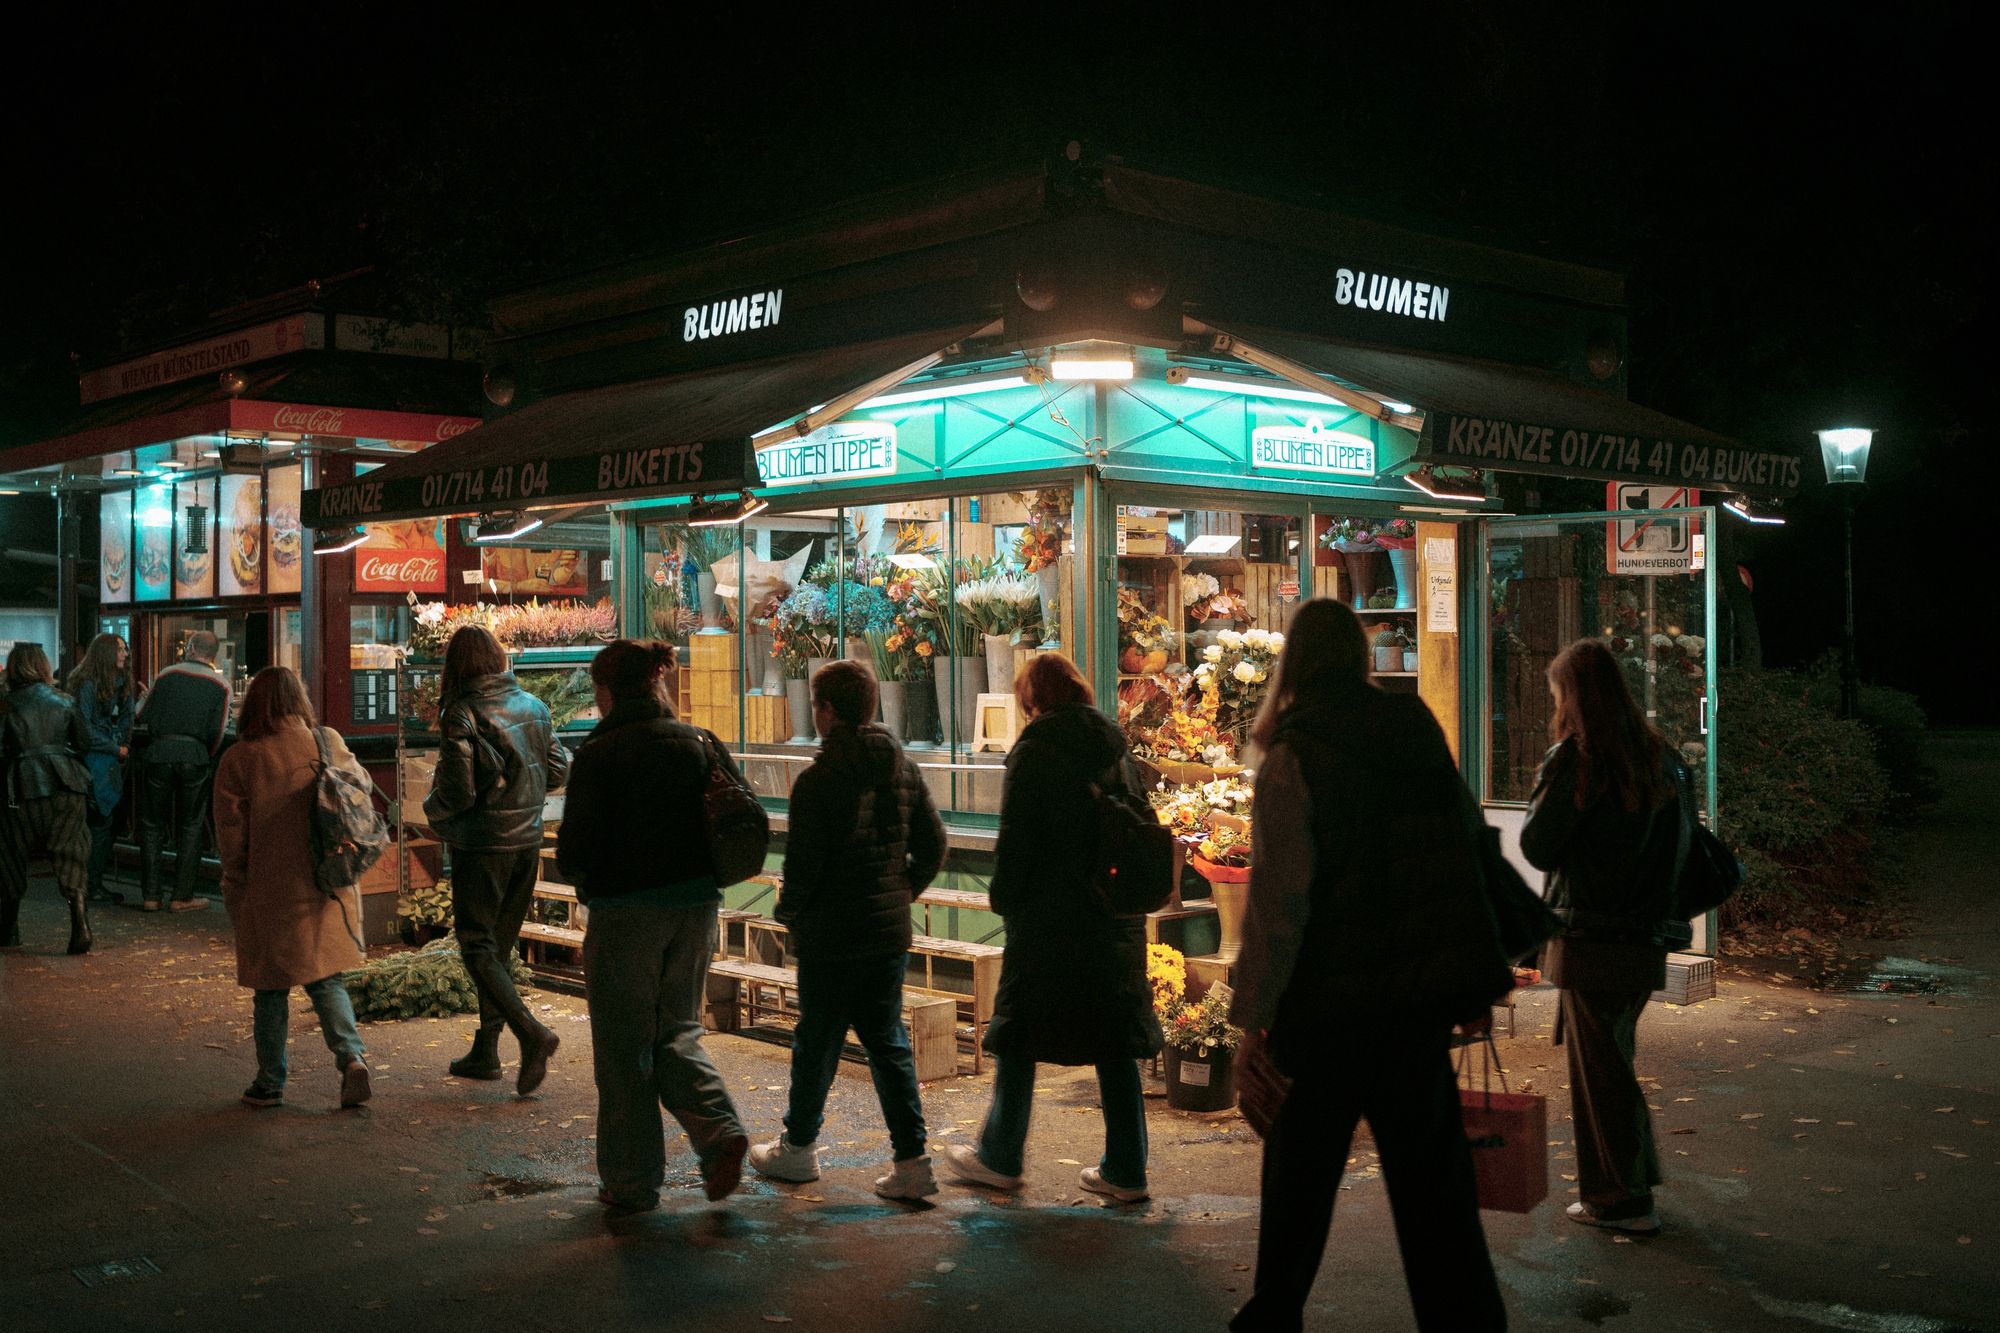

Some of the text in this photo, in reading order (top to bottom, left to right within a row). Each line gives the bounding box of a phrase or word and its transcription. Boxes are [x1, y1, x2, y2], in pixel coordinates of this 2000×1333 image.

[1334, 267, 1450, 323] BLUMEN
[683, 288, 783, 342] BLUMEN
[121, 362, 161, 389] WIENER
[757, 443, 827, 481] BLUMEN
[1263, 438, 1323, 467] BLUMEN
[1447, 415, 1800, 488] KRÄNZE 01/714 41 04 BUKETTS
[421, 468, 485, 508] 01/714
[490, 465, 514, 499] 41
[520, 461, 549, 497] 04
[599, 443, 704, 490] BUKETTS
[361, 556, 439, 582] Coca-Cola
[1617, 558, 1689, 568] HUNDEVERBOT
